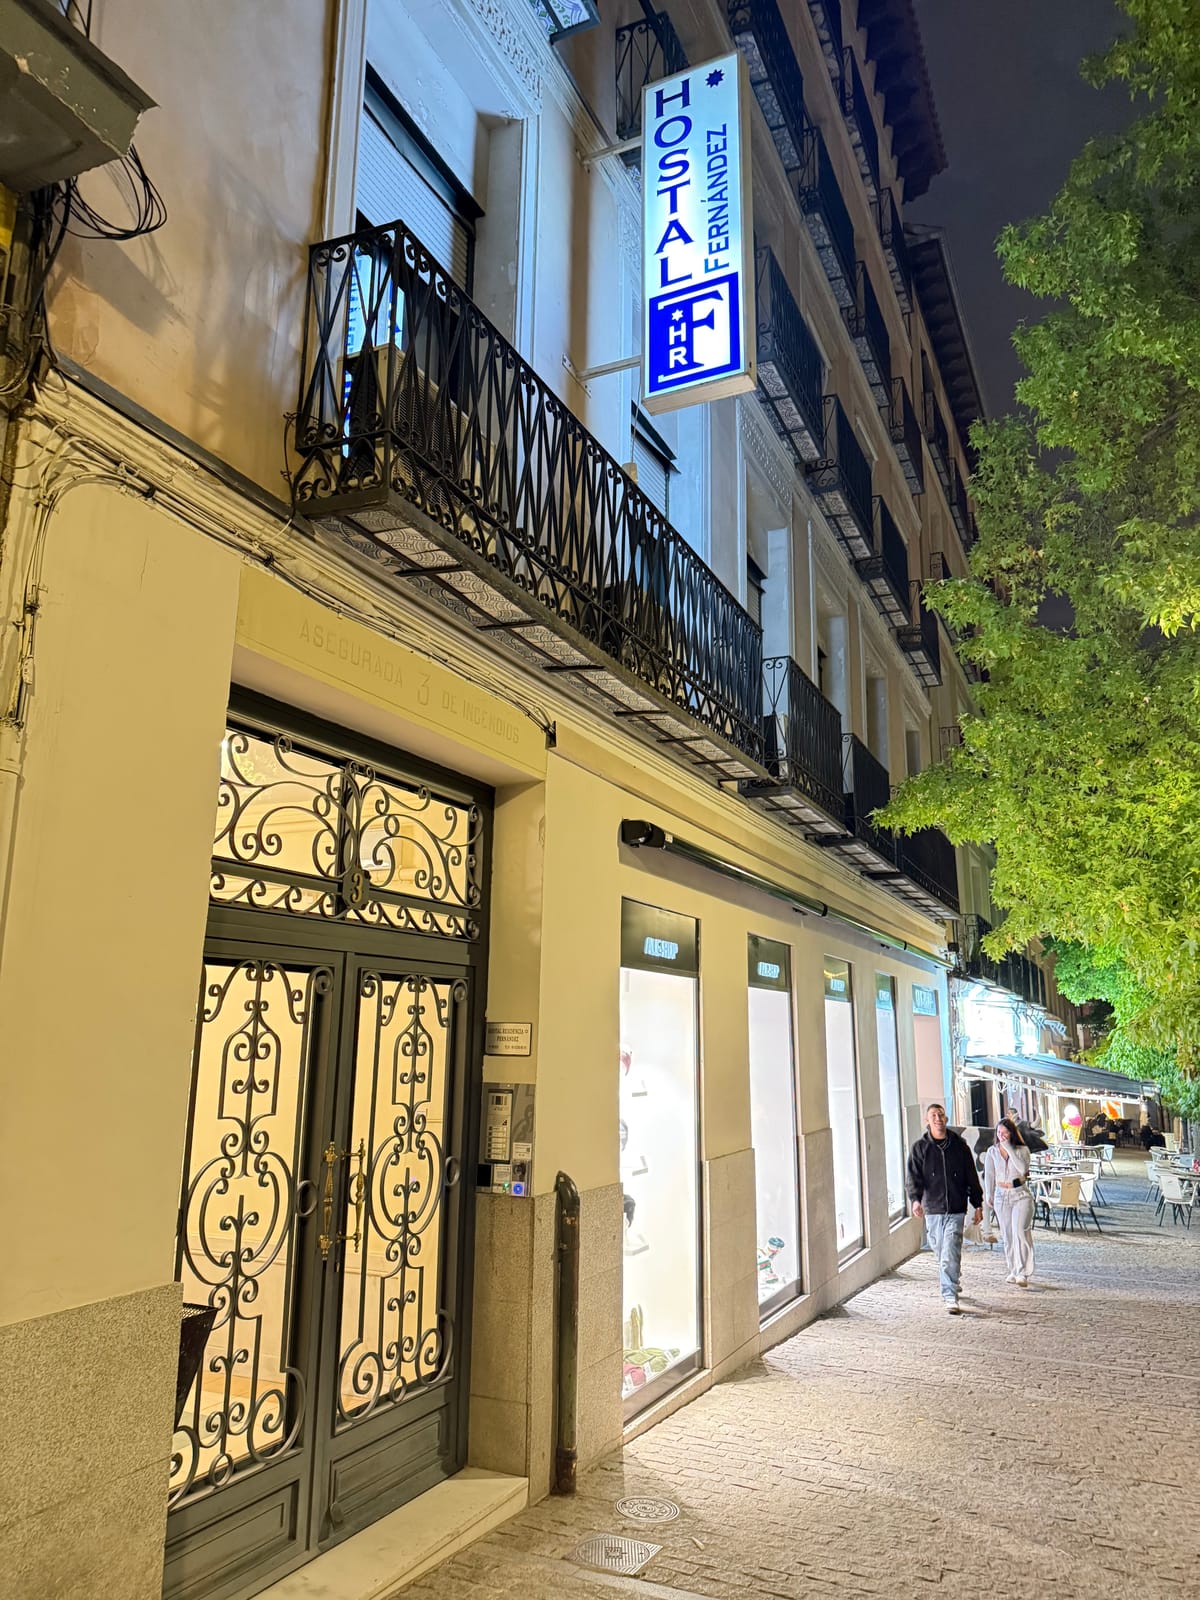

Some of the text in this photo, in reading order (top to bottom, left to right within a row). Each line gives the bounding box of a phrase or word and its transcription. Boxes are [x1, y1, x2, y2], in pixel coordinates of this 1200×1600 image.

[654, 77, 694, 288] HOSTAL
[701, 123, 731, 274] FERNÁNDEZ
[299, 617, 404, 689] ASEGURADA
[416, 672, 432, 707] 3
[441, 689, 520, 744] DE INCENDIOS
[351, 872, 363, 904] 3
